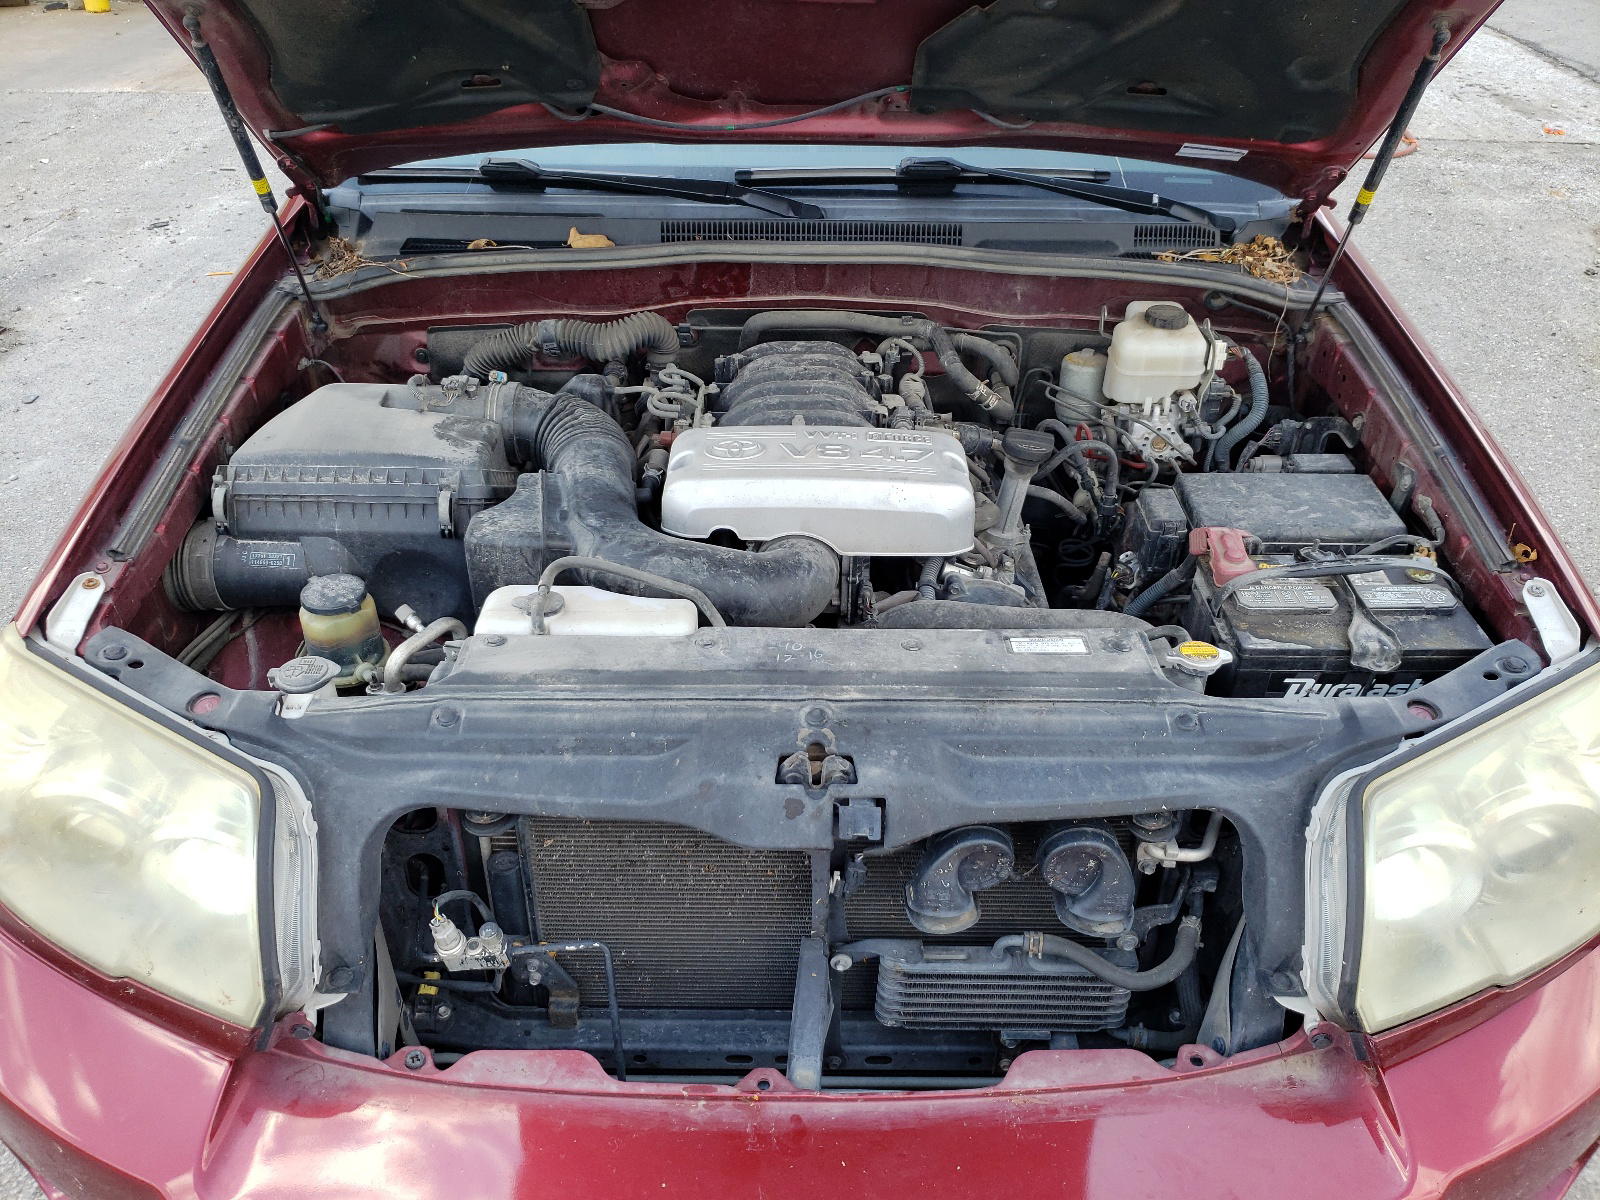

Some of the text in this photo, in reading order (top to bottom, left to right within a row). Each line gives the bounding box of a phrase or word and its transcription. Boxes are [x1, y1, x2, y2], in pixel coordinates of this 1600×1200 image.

[779, 442, 935, 463] V8 4.7
[1283, 678, 1424, 698] Duraast
